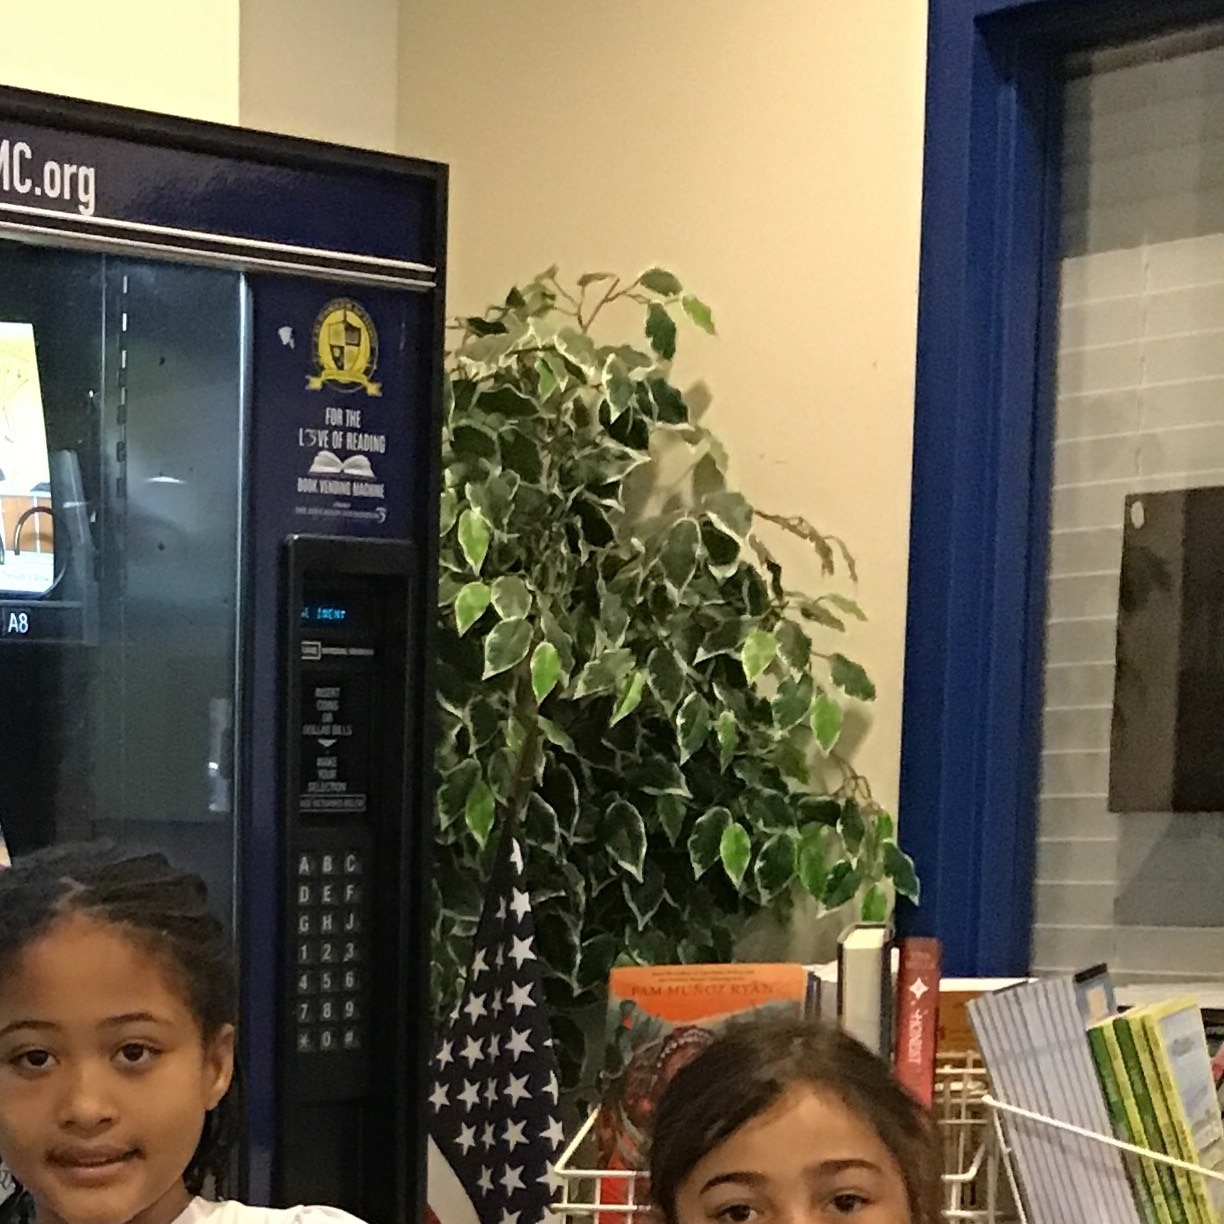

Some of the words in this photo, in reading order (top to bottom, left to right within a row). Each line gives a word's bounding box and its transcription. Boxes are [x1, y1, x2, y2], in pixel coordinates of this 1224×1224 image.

[324, 407, 343, 428] FOR
[345, 409, 362, 429] THE
[331, 430, 344, 450] OF
[346, 432, 386, 453] READING
[8, 611, 29, 634] A8
[298, 855, 310, 875] A
[323, 855, 333, 872] B
[346, 854, 356, 872] C
[299, 885, 309, 903] D
[323, 884, 331, 902] E
[346, 884, 354, 901] F
[299, 914, 309, 933] G
[323, 914, 333, 931] H
[346, 913, 354, 930] J
[301, 943, 308, 960] 1
[323, 943, 332, 961] 2
[346, 942, 355, 960] 3
[299, 974, 308, 990] 4
[323, 972, 331, 989] 5
[345, 971, 354, 988] 6
[631, 984, 662, 998] PAM
[731, 981, 774, 997] RYAN
[300, 1003, 309, 1020] 7
[323, 1002, 332, 1019] 8
[345, 1001, 354, 1018] 9
[322, 1031, 331, 1047] 0
